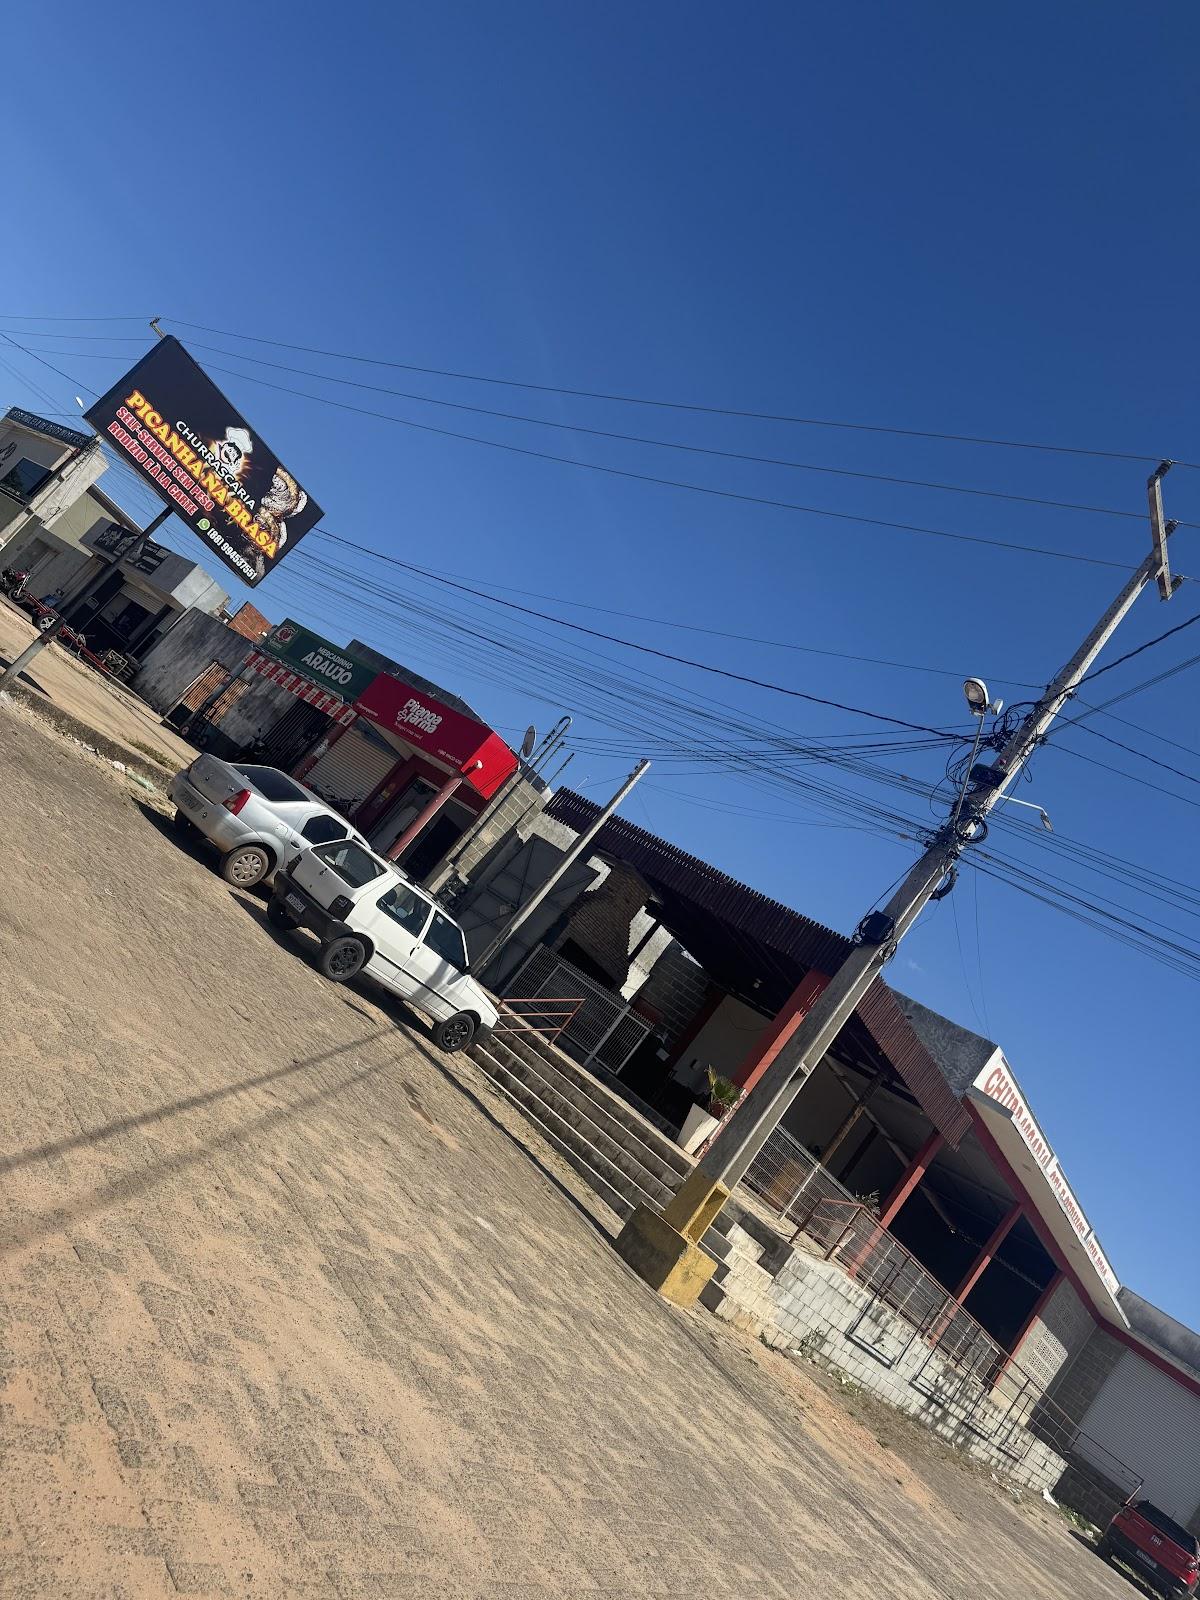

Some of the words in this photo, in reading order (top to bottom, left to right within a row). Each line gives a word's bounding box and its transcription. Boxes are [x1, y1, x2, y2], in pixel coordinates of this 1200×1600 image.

[107, 420, 148, 463] RODÍZIO
[142, 457, 154, 470] E
[155, 471, 172, 490] LA
[167, 483, 199, 516] CARTE
[115, 406, 178, 472] SELF-SERVICE
[172, 466, 196, 491] SEM
[189, 484, 215, 512] PESO
[125, 389, 205, 479] PICANHA
[200, 471, 229, 505] NA
[225, 498, 279, 559] BRASA
[175, 420, 256, 510] CHURRASCARIA
[207, 528, 225, 547] (88)
[300, 651, 353, 685] ARAUJO
[317, 646, 354, 670] MERCADINHO
